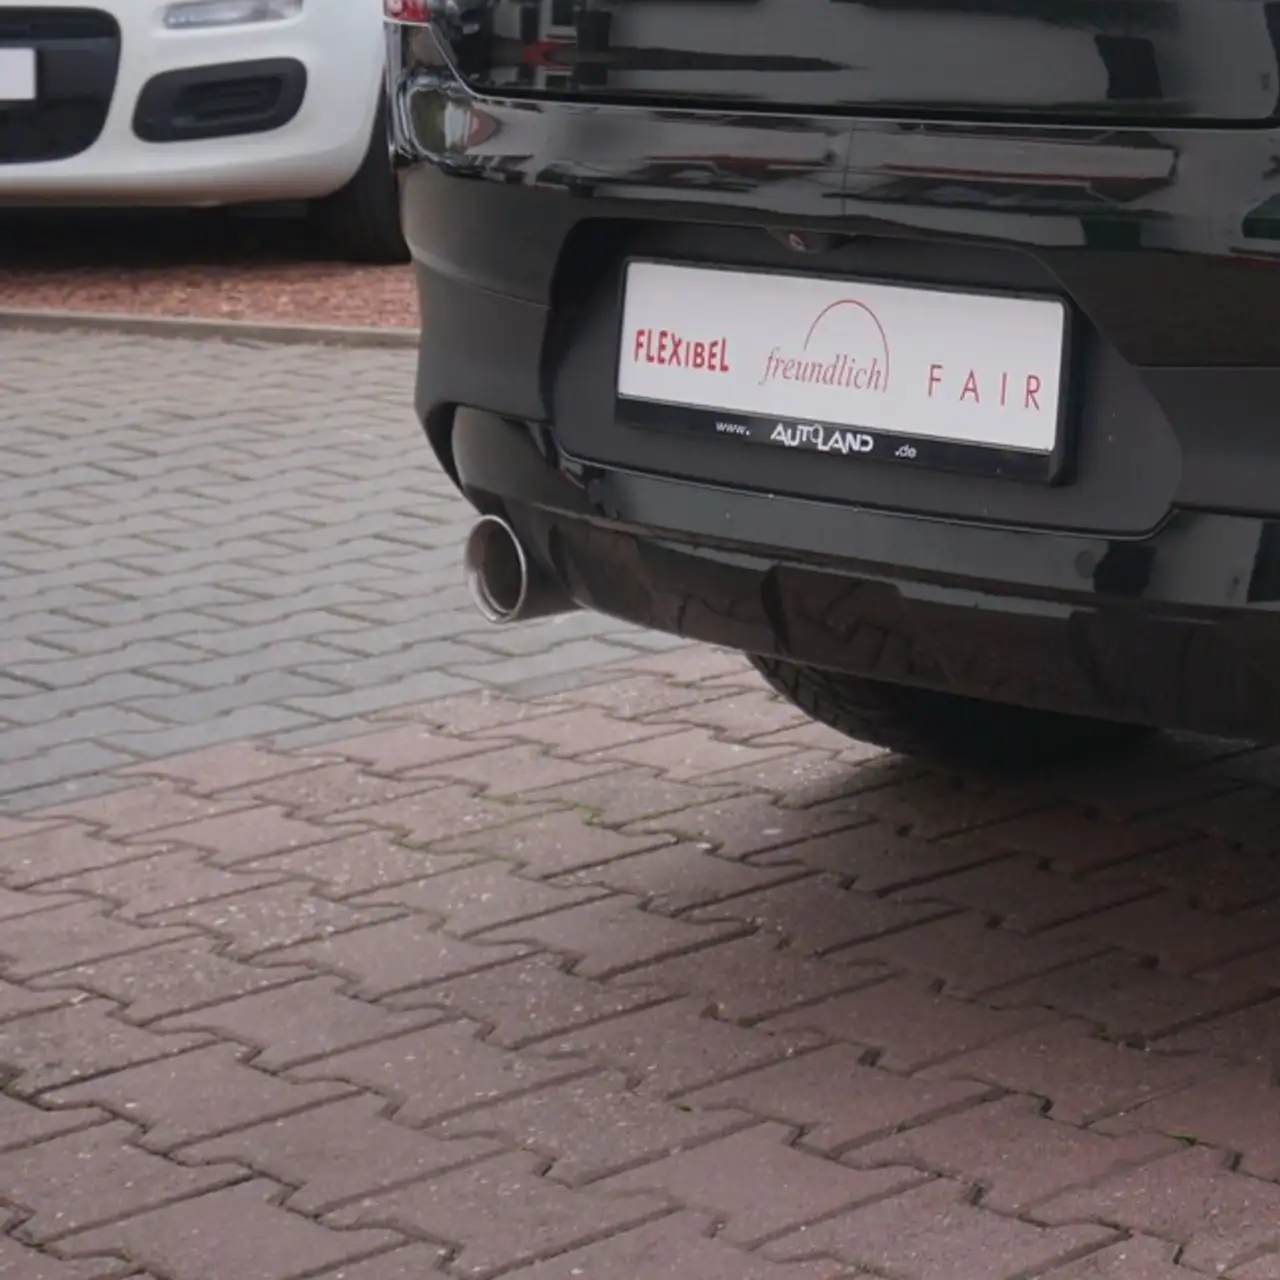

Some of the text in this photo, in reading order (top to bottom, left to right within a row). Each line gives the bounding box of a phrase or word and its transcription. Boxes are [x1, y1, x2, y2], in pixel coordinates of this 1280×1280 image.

[634, 328, 1042, 411] FLEXIBEL freundlich FAIR
[770, 423, 874, 455] AUTOLAND
